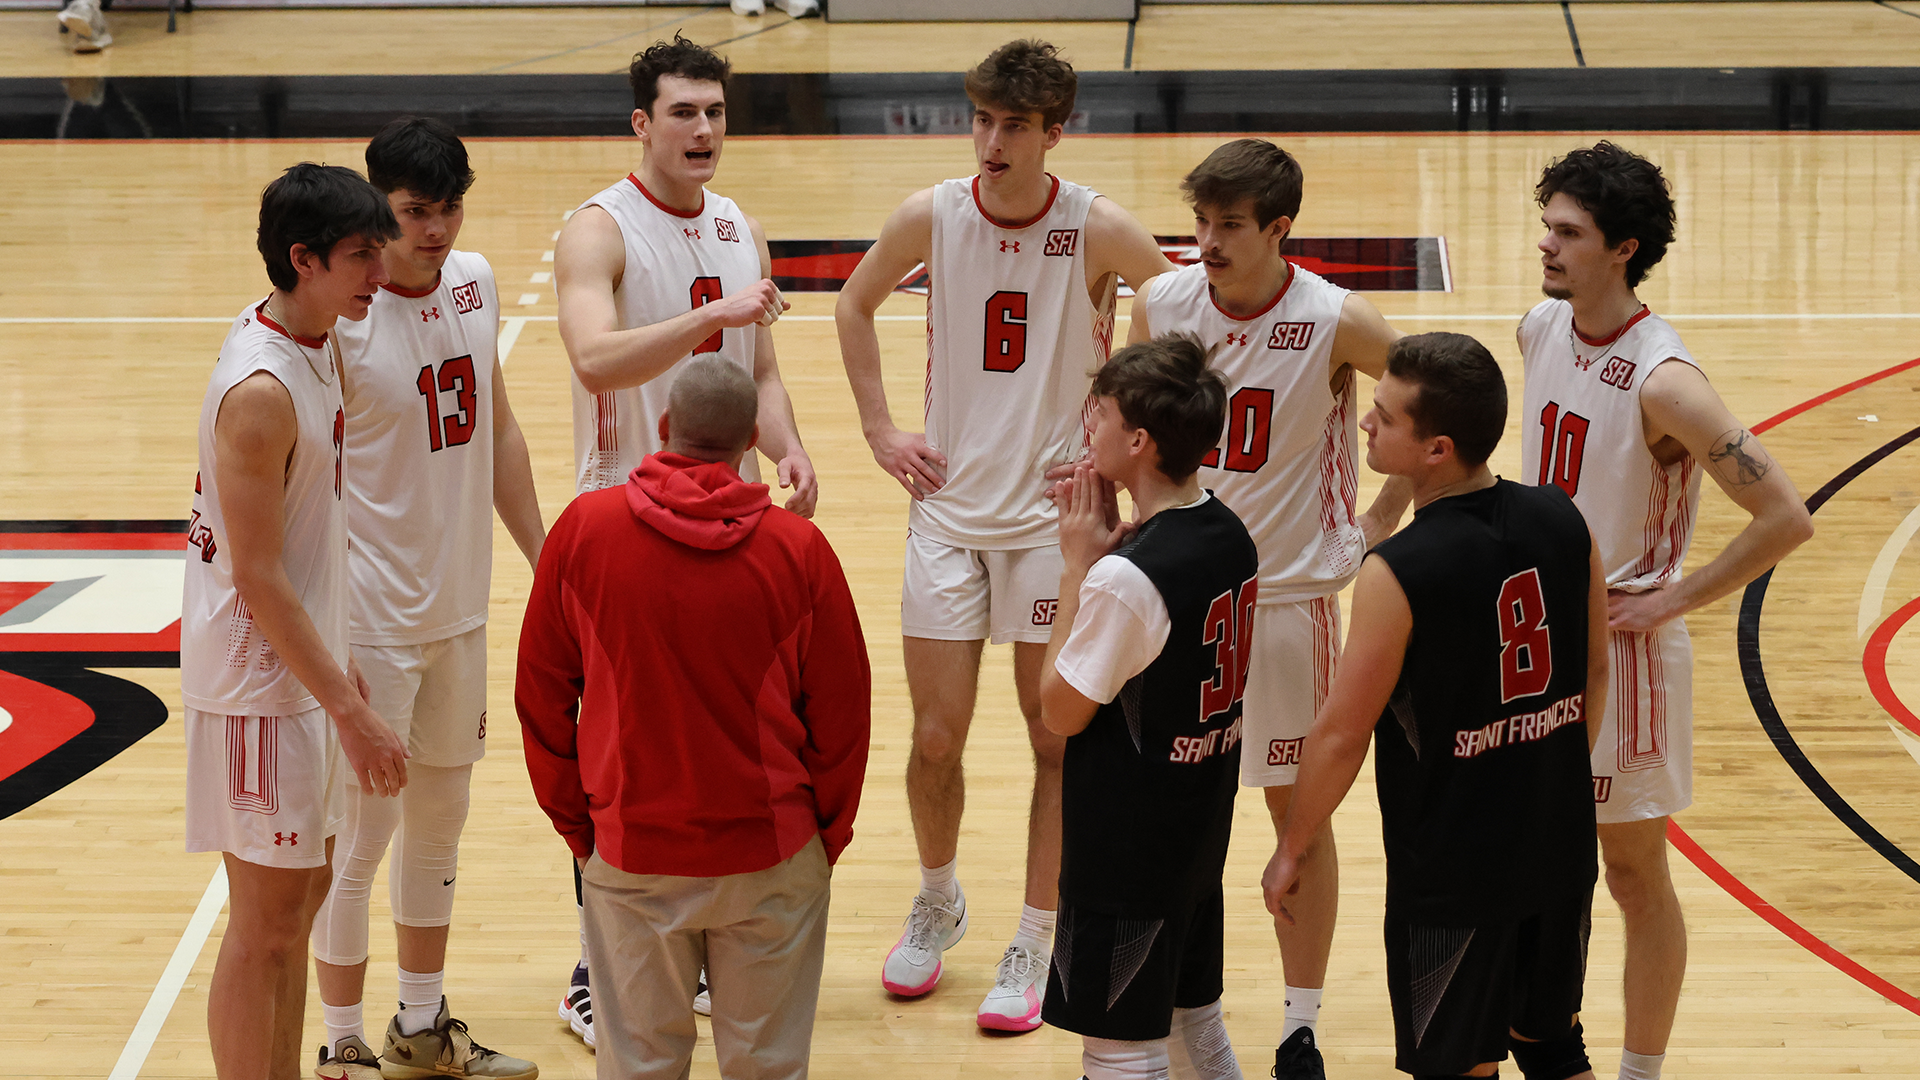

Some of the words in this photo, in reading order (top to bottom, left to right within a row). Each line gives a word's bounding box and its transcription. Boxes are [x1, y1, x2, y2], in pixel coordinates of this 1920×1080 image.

[452, 280, 483, 314] SFU
[983, 290, 1028, 373] 6
[1267, 322, 1316, 351] SFU
[416, 354, 477, 453] 13
[1600, 356, 1637, 391] SFU
[1200, 386, 1275, 474] 0
[1538, 400, 1590, 499] 10
[1199, 573, 1258, 723] 30
[1497, 567, 1552, 705] 8
[1454, 717, 1509, 758] SAINT
[1507, 693, 1585, 745] FRANCIS
